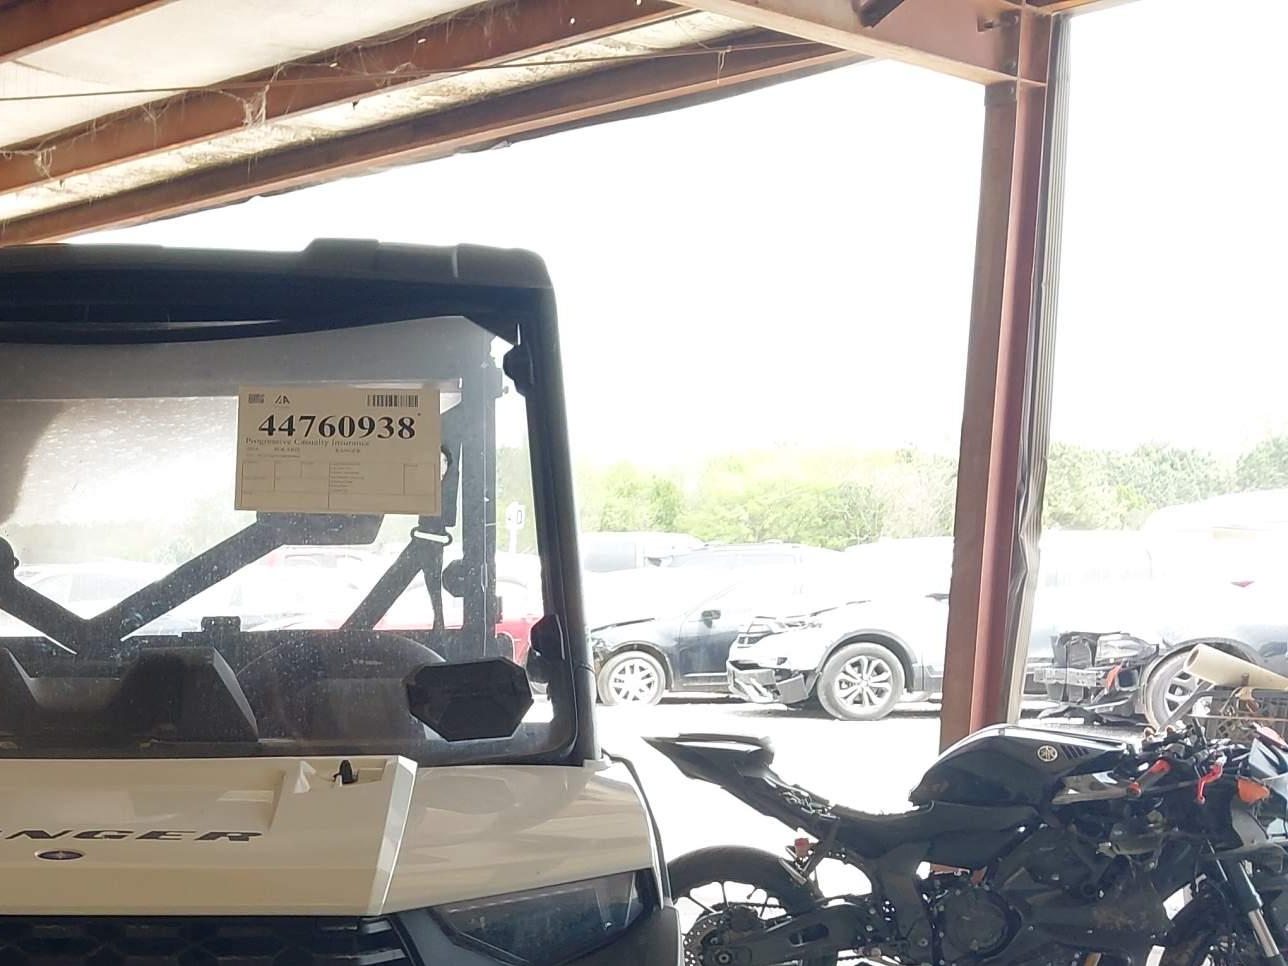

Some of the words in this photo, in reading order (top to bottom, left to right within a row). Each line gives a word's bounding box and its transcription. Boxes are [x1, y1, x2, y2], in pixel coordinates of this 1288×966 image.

[259, 415, 414, 438] 44760938
[245, 437, 291, 447] Progressive
[294, 439, 329, 448] Casualty
[332, 440, 370, 448] Insurance
